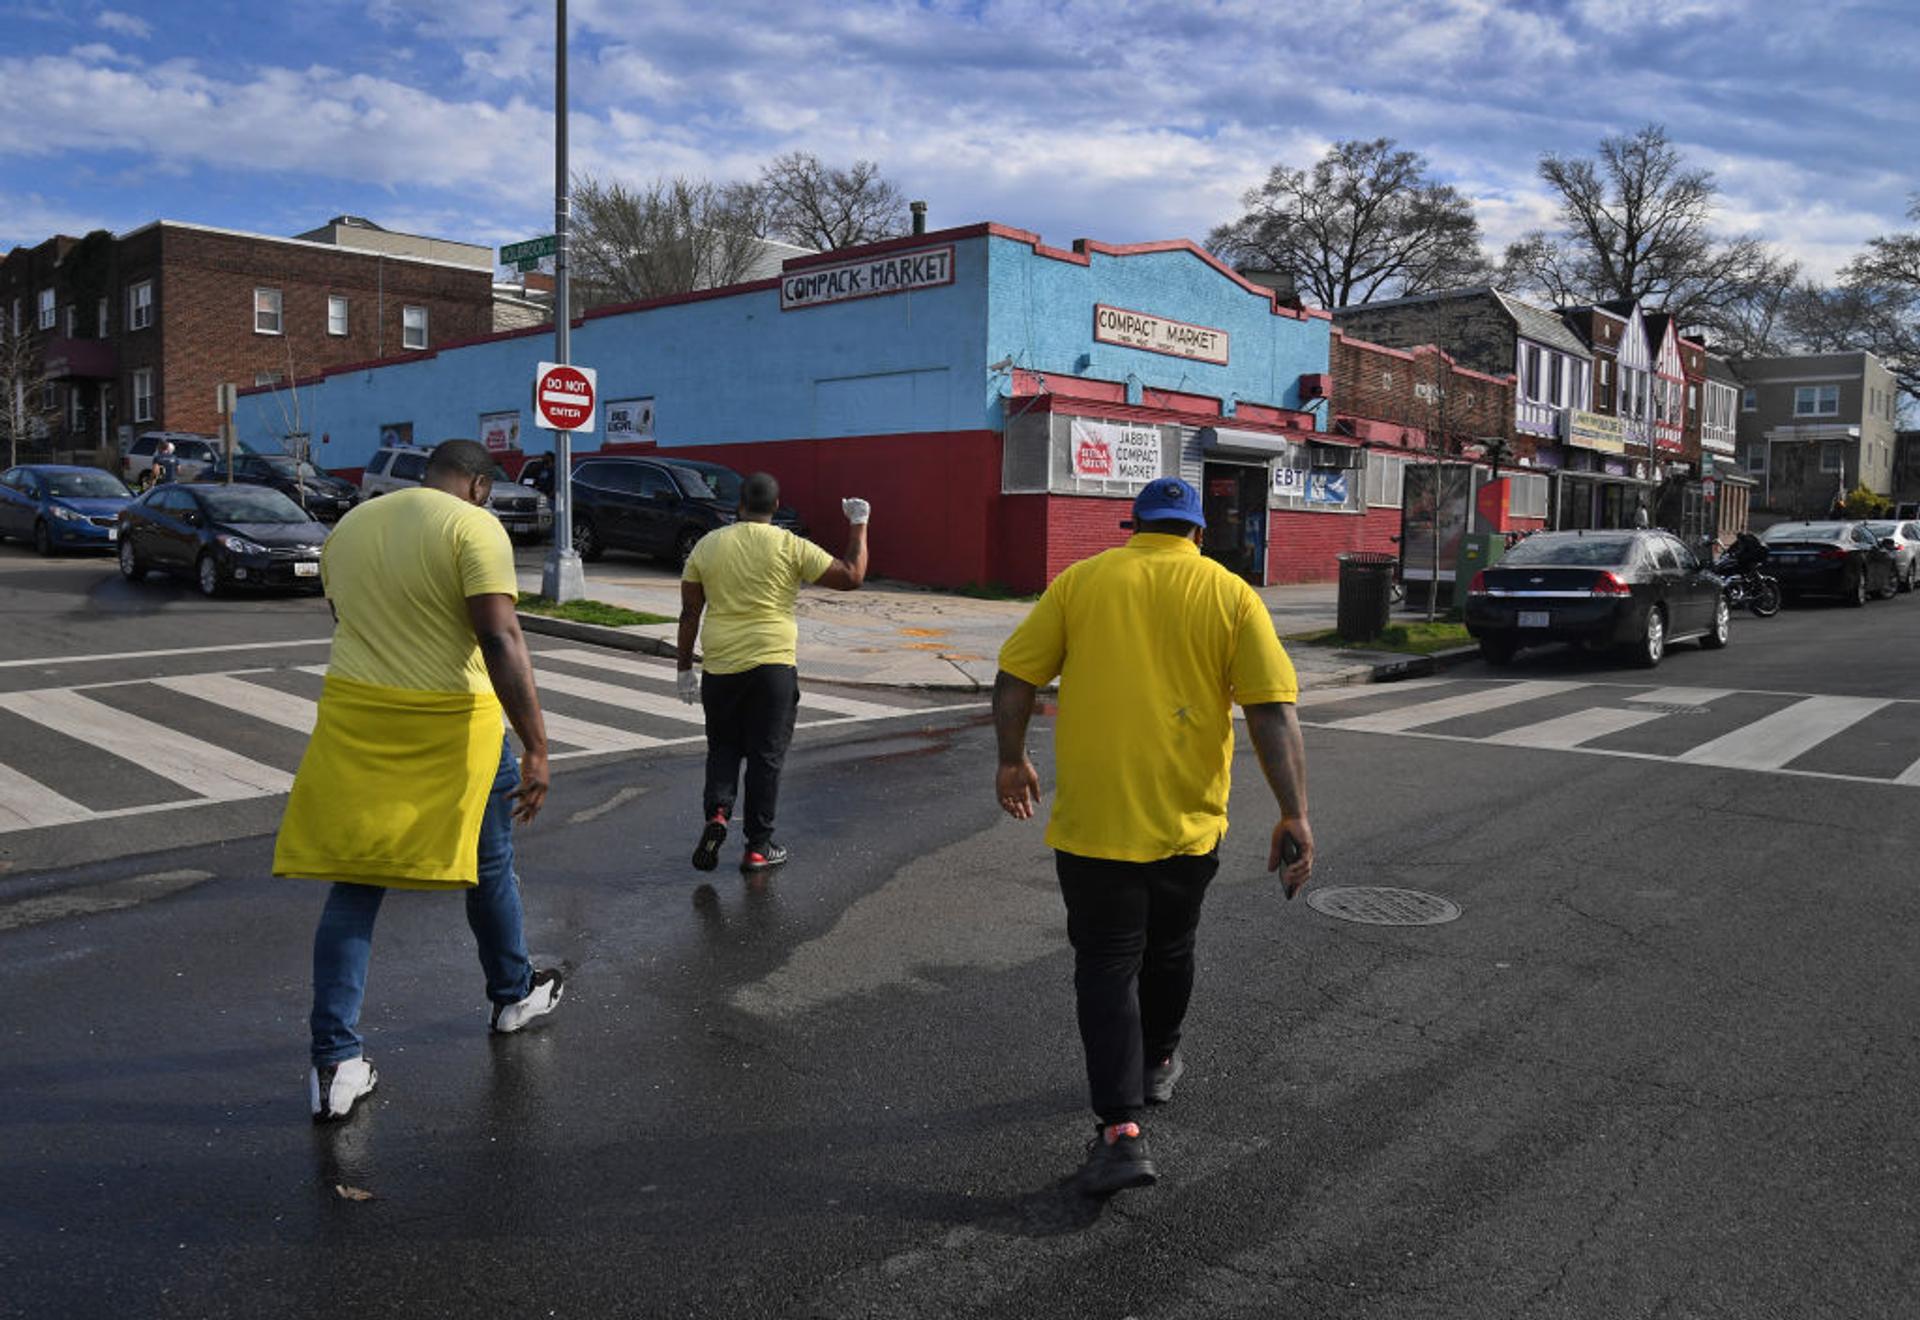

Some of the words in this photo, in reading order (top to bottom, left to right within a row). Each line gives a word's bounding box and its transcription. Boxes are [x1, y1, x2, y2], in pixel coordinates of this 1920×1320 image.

[784, 252, 949, 301] COMPACK-MARKET
[1099, 310, 1157, 338] COMPACT
[1166, 325, 1218, 350] MARKET
[547, 377, 562, 390] DO
[565, 380, 587, 393] NOT
[550, 406, 581, 418] ENTER
[1116, 447, 1158, 464] COMPACT
[1119, 464, 1156, 479] MARKET
[1276, 468, 1303, 487] EBT
